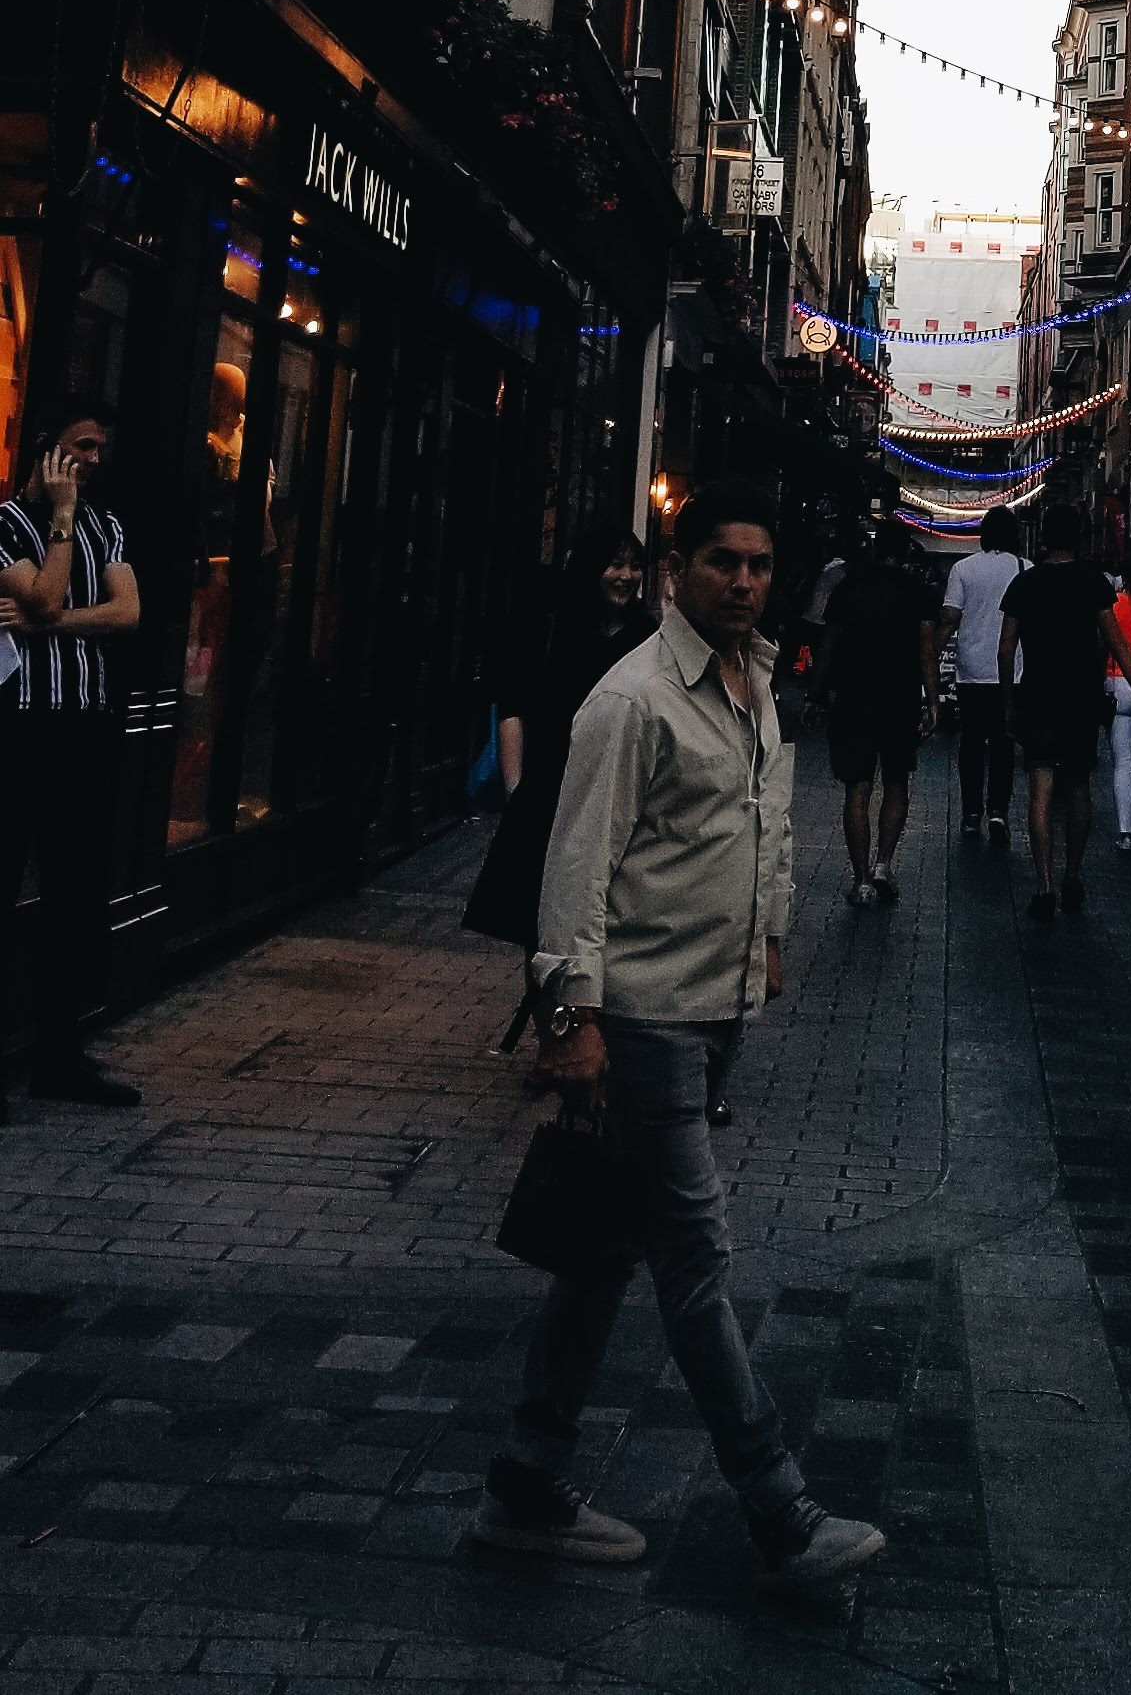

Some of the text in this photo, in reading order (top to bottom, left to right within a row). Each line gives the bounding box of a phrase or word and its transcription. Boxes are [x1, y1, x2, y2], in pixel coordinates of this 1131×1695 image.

[305, 123, 410, 251] JACK WILLS
[734, 199, 775, 212] TAORS
